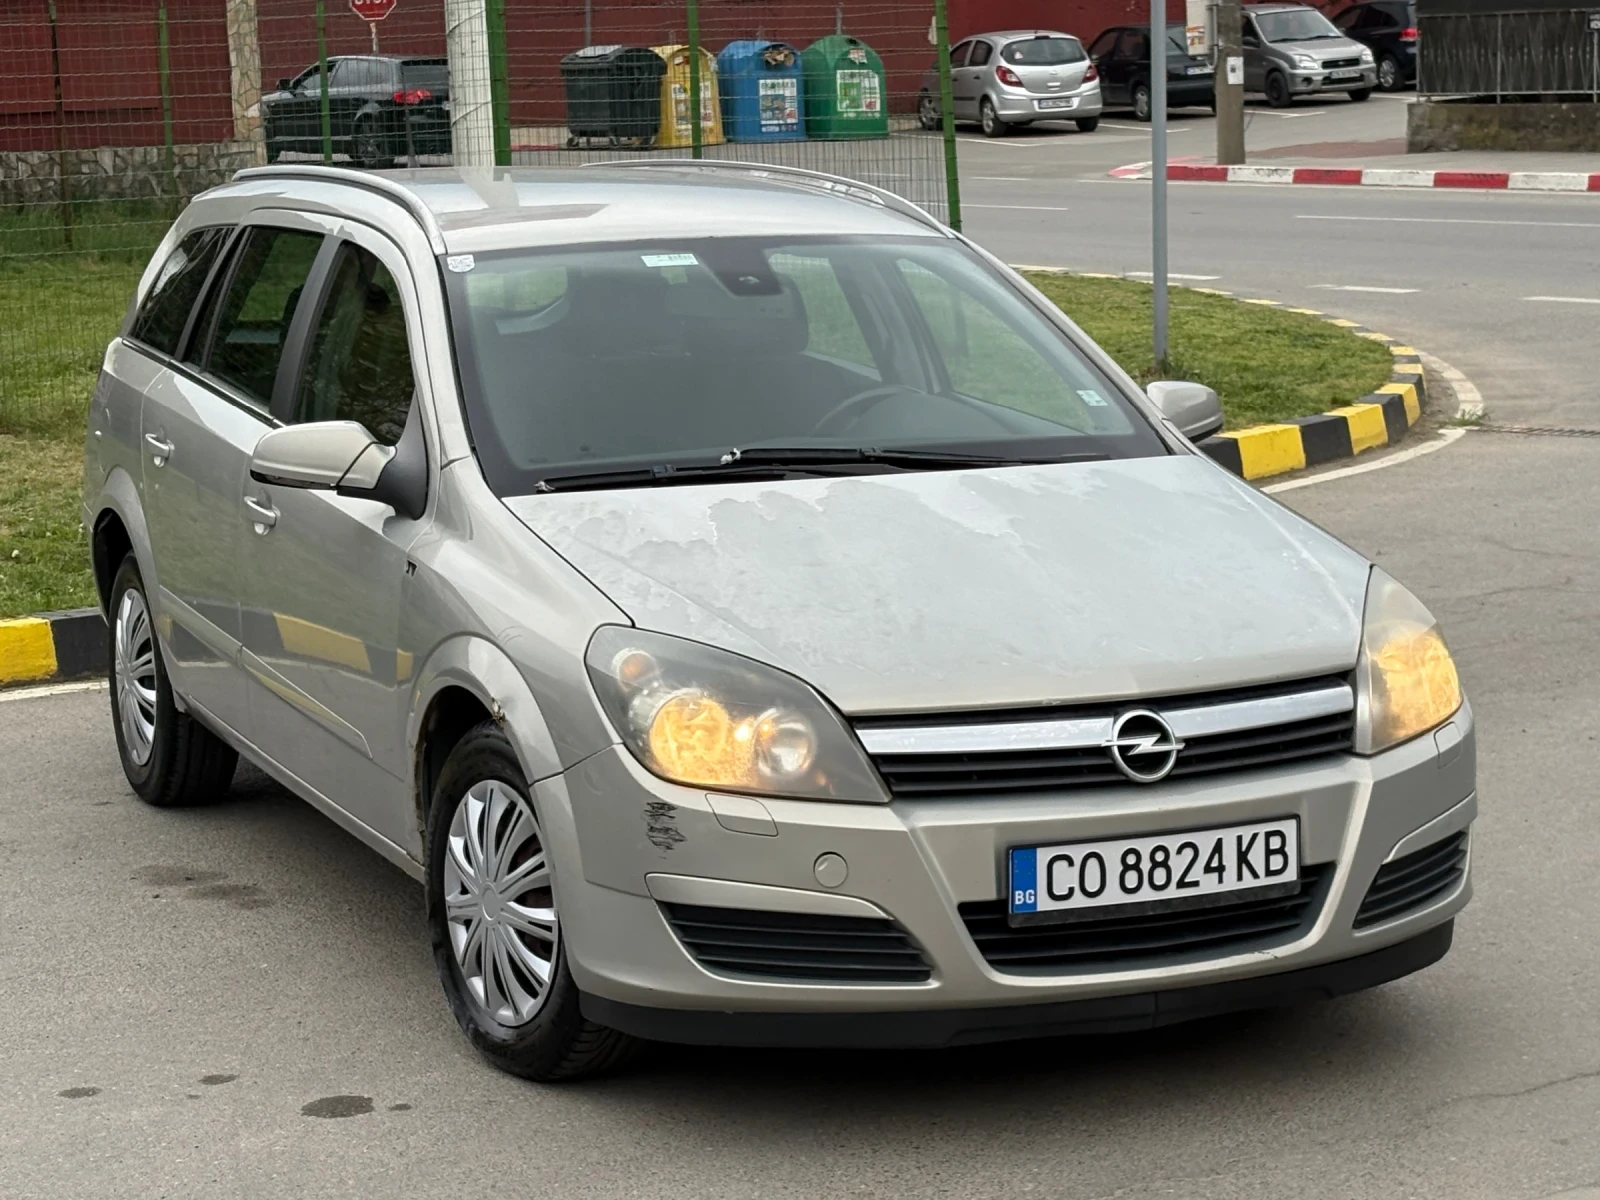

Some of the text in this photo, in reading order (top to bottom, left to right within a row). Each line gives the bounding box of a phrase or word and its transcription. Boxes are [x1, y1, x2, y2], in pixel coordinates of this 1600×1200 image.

[1047, 830, 1289, 901] CO 8824 KB
[1014, 889, 1035, 905] BG
